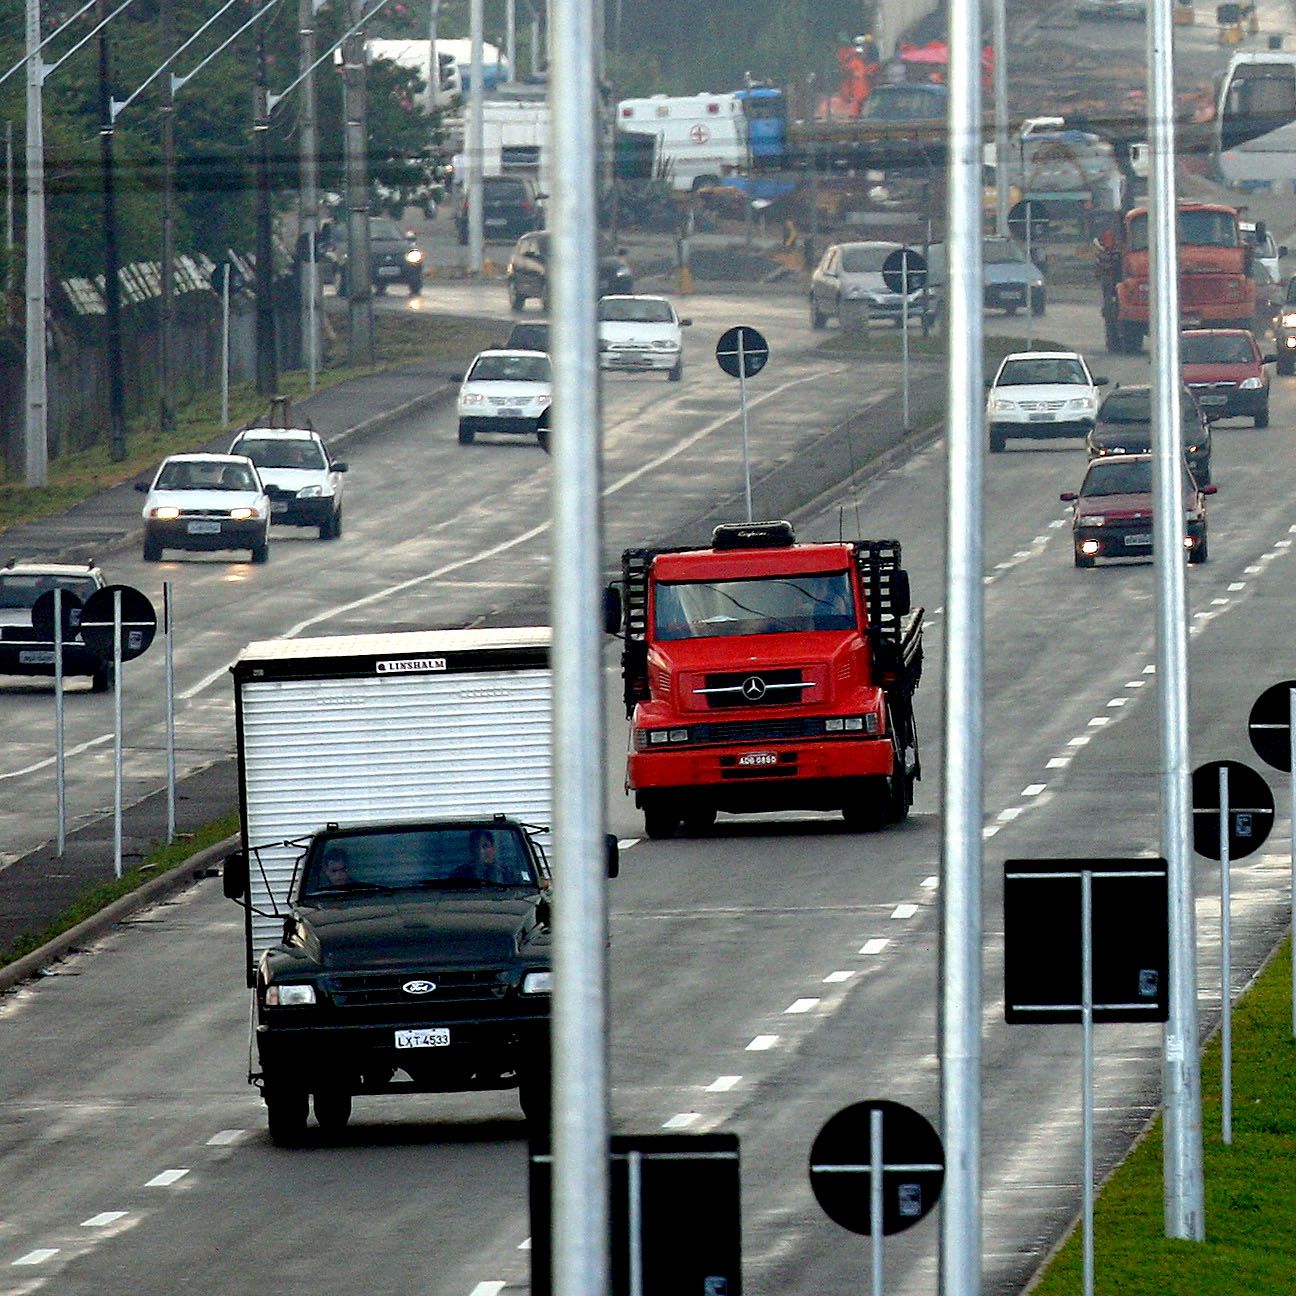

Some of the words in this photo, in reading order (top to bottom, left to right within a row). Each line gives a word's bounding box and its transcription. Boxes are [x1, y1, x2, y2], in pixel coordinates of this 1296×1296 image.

[388, 660, 445, 671] LINSHALM
[398, 1036, 420, 1048] LXT
[423, 1034, 449, 1046] 4533
